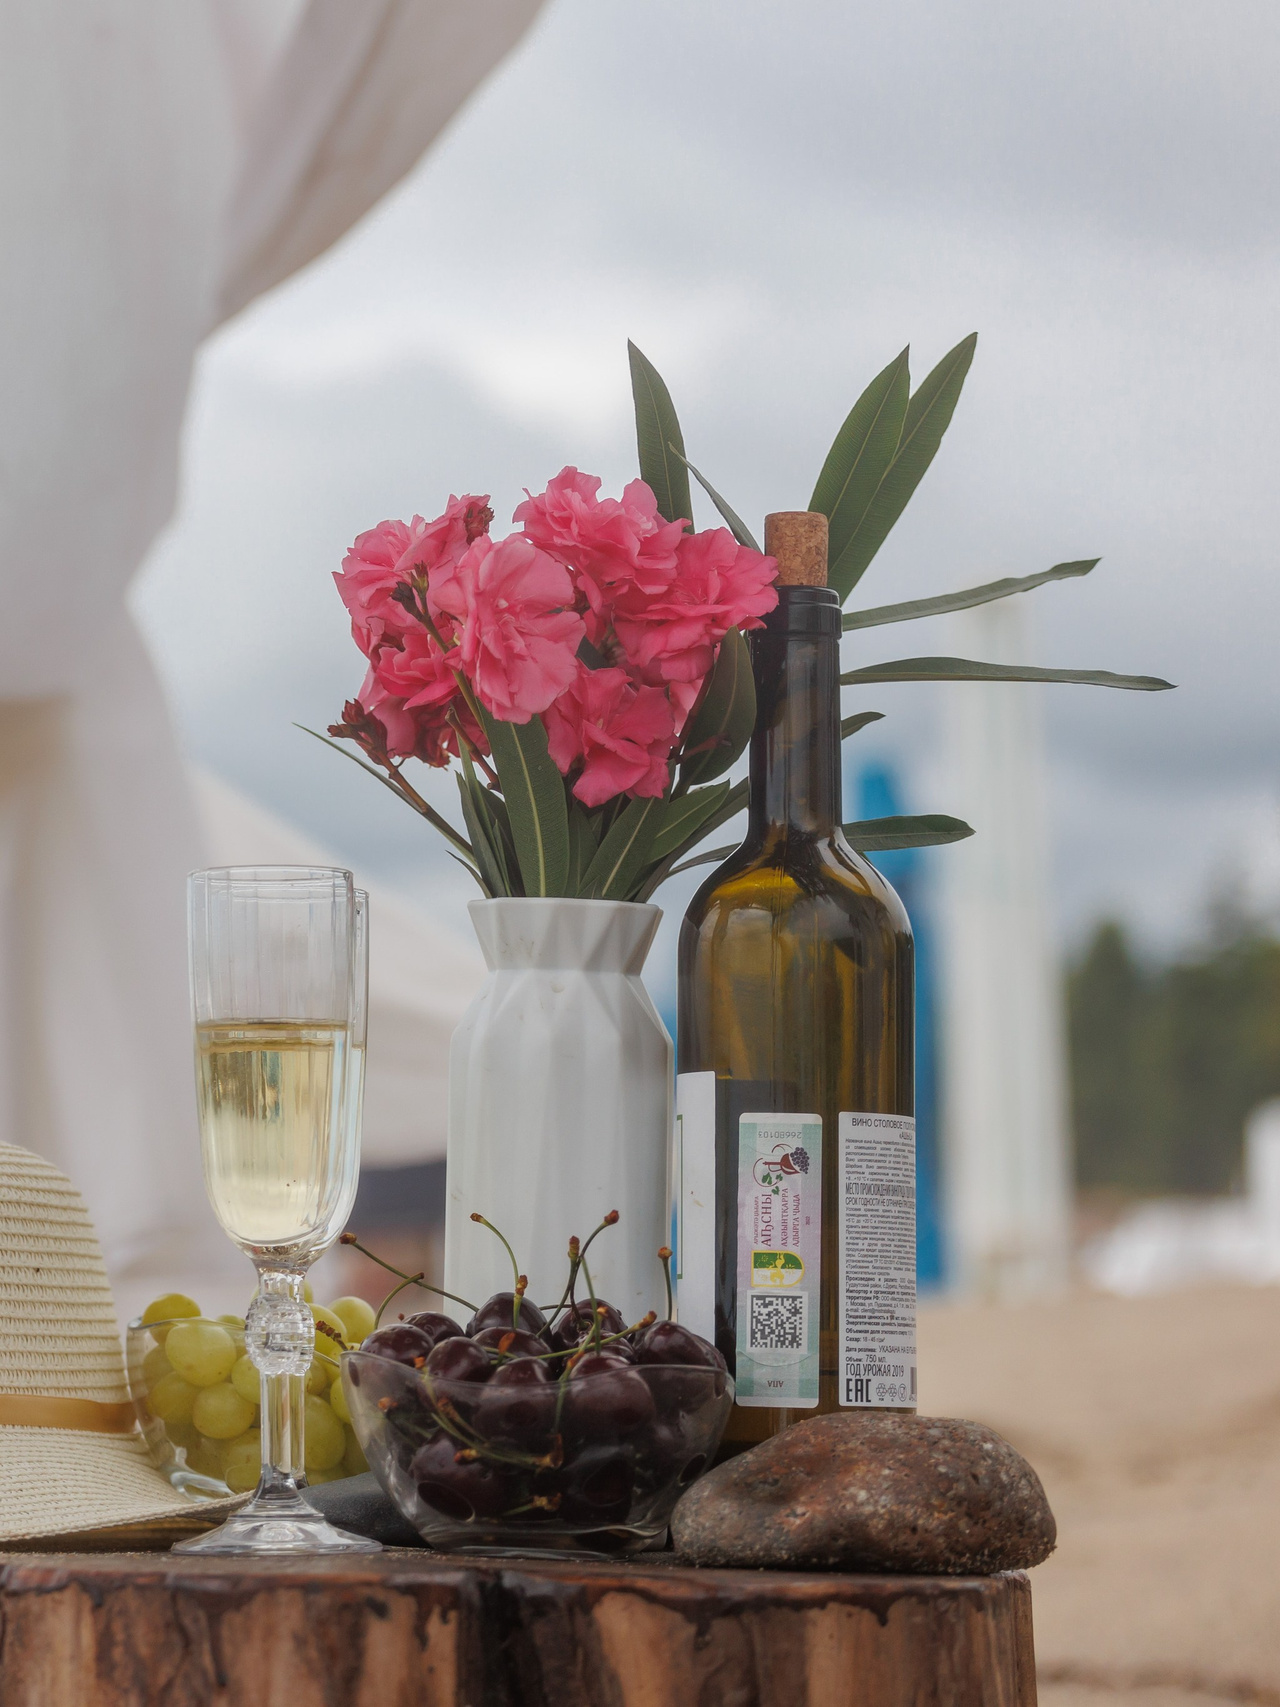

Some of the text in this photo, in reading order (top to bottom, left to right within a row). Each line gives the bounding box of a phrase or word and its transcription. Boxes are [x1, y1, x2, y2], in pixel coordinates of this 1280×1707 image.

[852, 1118, 872, 1127] ВИНО
[874, 1119, 903, 1129] СТОЛОВОЕ
[846, 1183, 859, 1195] МЕСТО
[845, 1197, 858, 1206] СРОК
[859, 1198, 880, 1207] ГОДНОСТИ
[879, 1345, 900, 1353] УКАЗАНА
[866, 1354, 877, 1363] 750
[846, 1363, 904, 1378] ГОД УРОЖАЯ 2019
